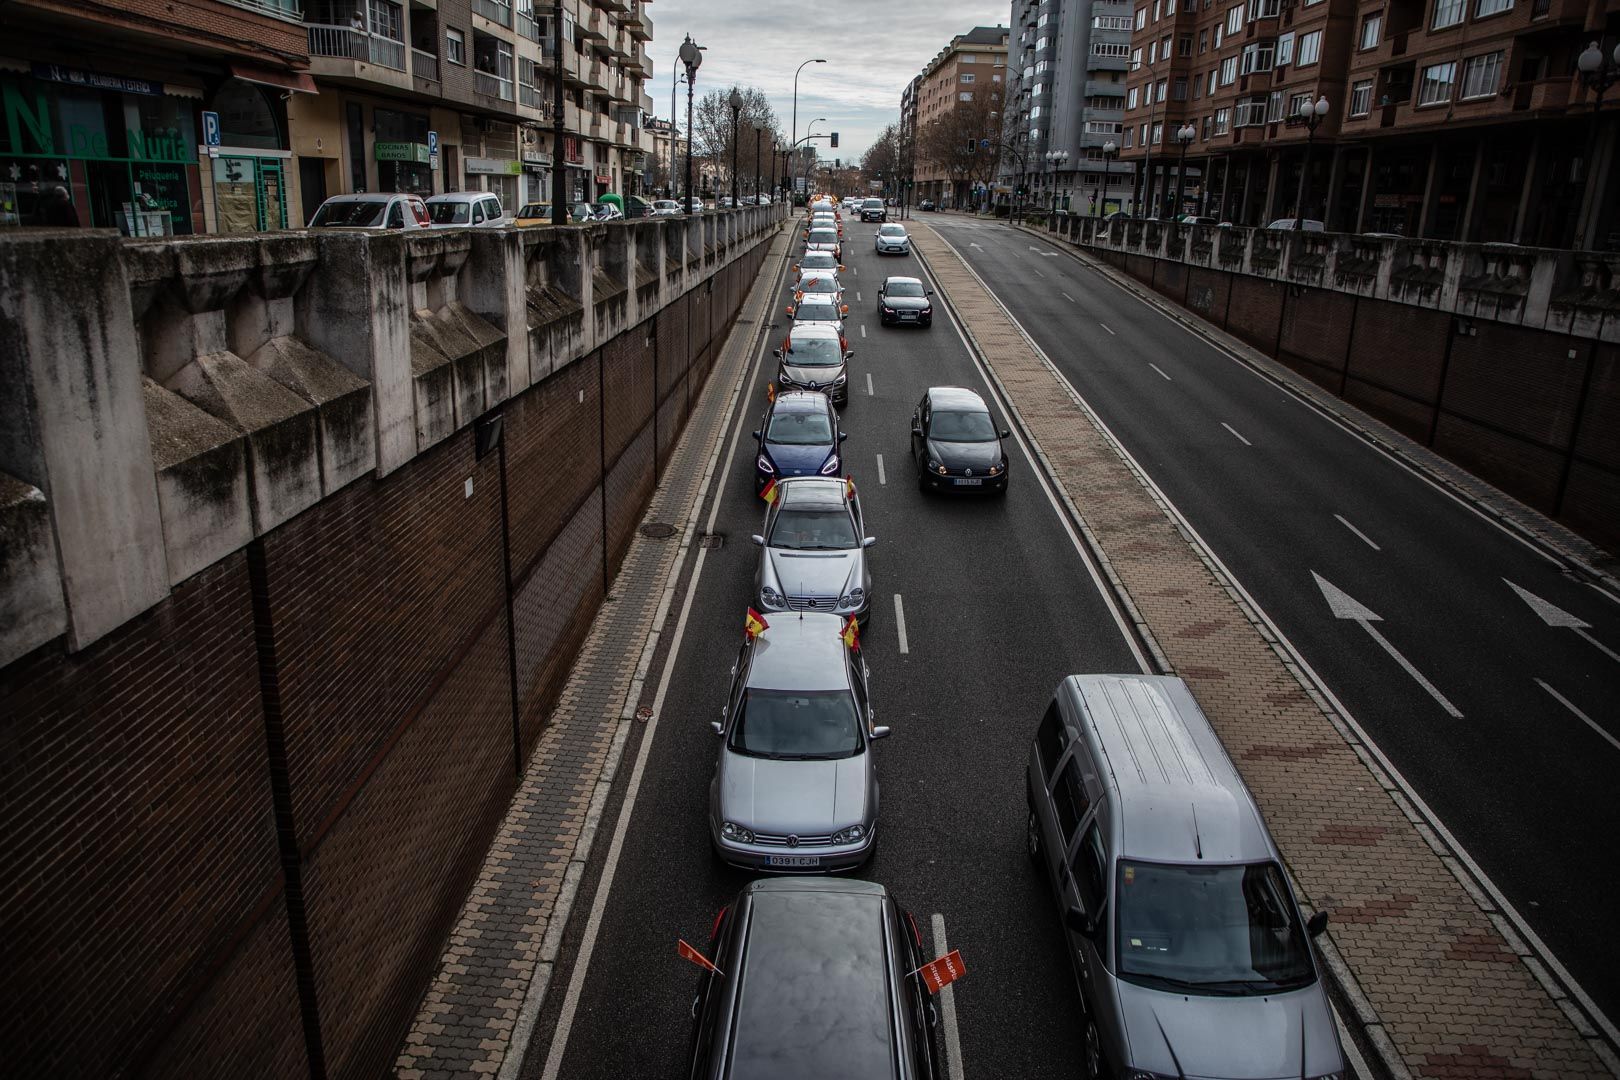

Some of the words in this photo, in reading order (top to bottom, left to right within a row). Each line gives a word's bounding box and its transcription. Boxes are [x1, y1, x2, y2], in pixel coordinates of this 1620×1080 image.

[206, 115, 217, 144] P
[772, 857, 796, 865] 0391
[799, 857, 818, 866] CJH
